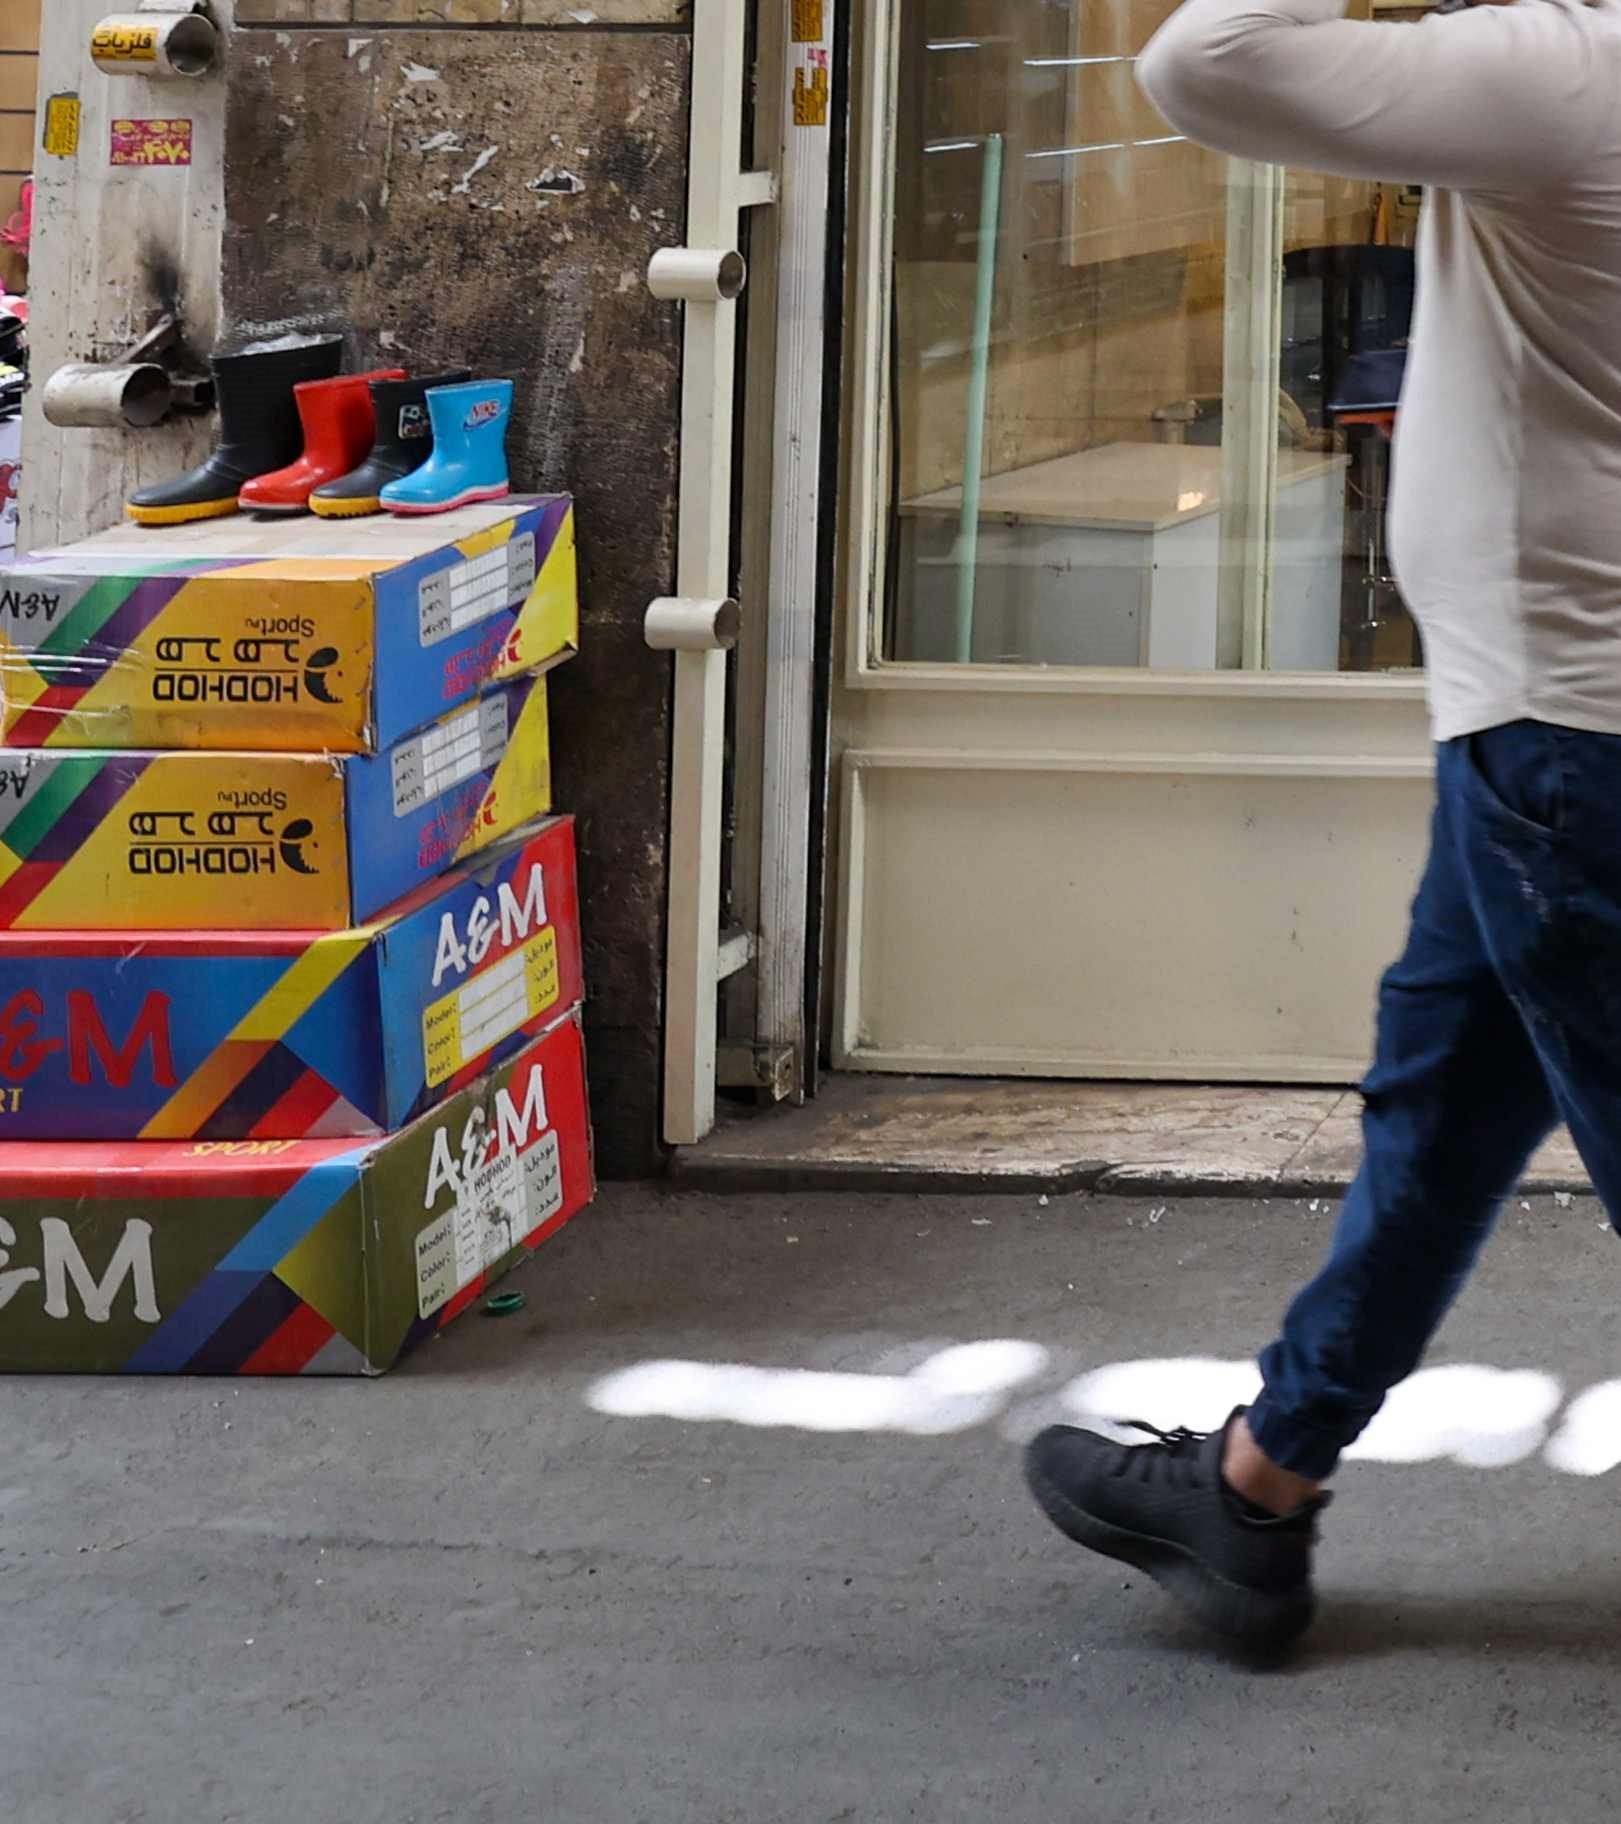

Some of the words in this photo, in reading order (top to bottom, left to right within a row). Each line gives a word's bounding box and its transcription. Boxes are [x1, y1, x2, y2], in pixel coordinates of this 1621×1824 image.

[260, 614, 316, 638] Sport
[152, 674, 299, 702] HODHOD
[233, 787, 288, 811] Sport
[128, 846, 276, 874] HODHOD
[431, 862, 548, 987] A&M
[423, 1063, 550, 1210] A&M
